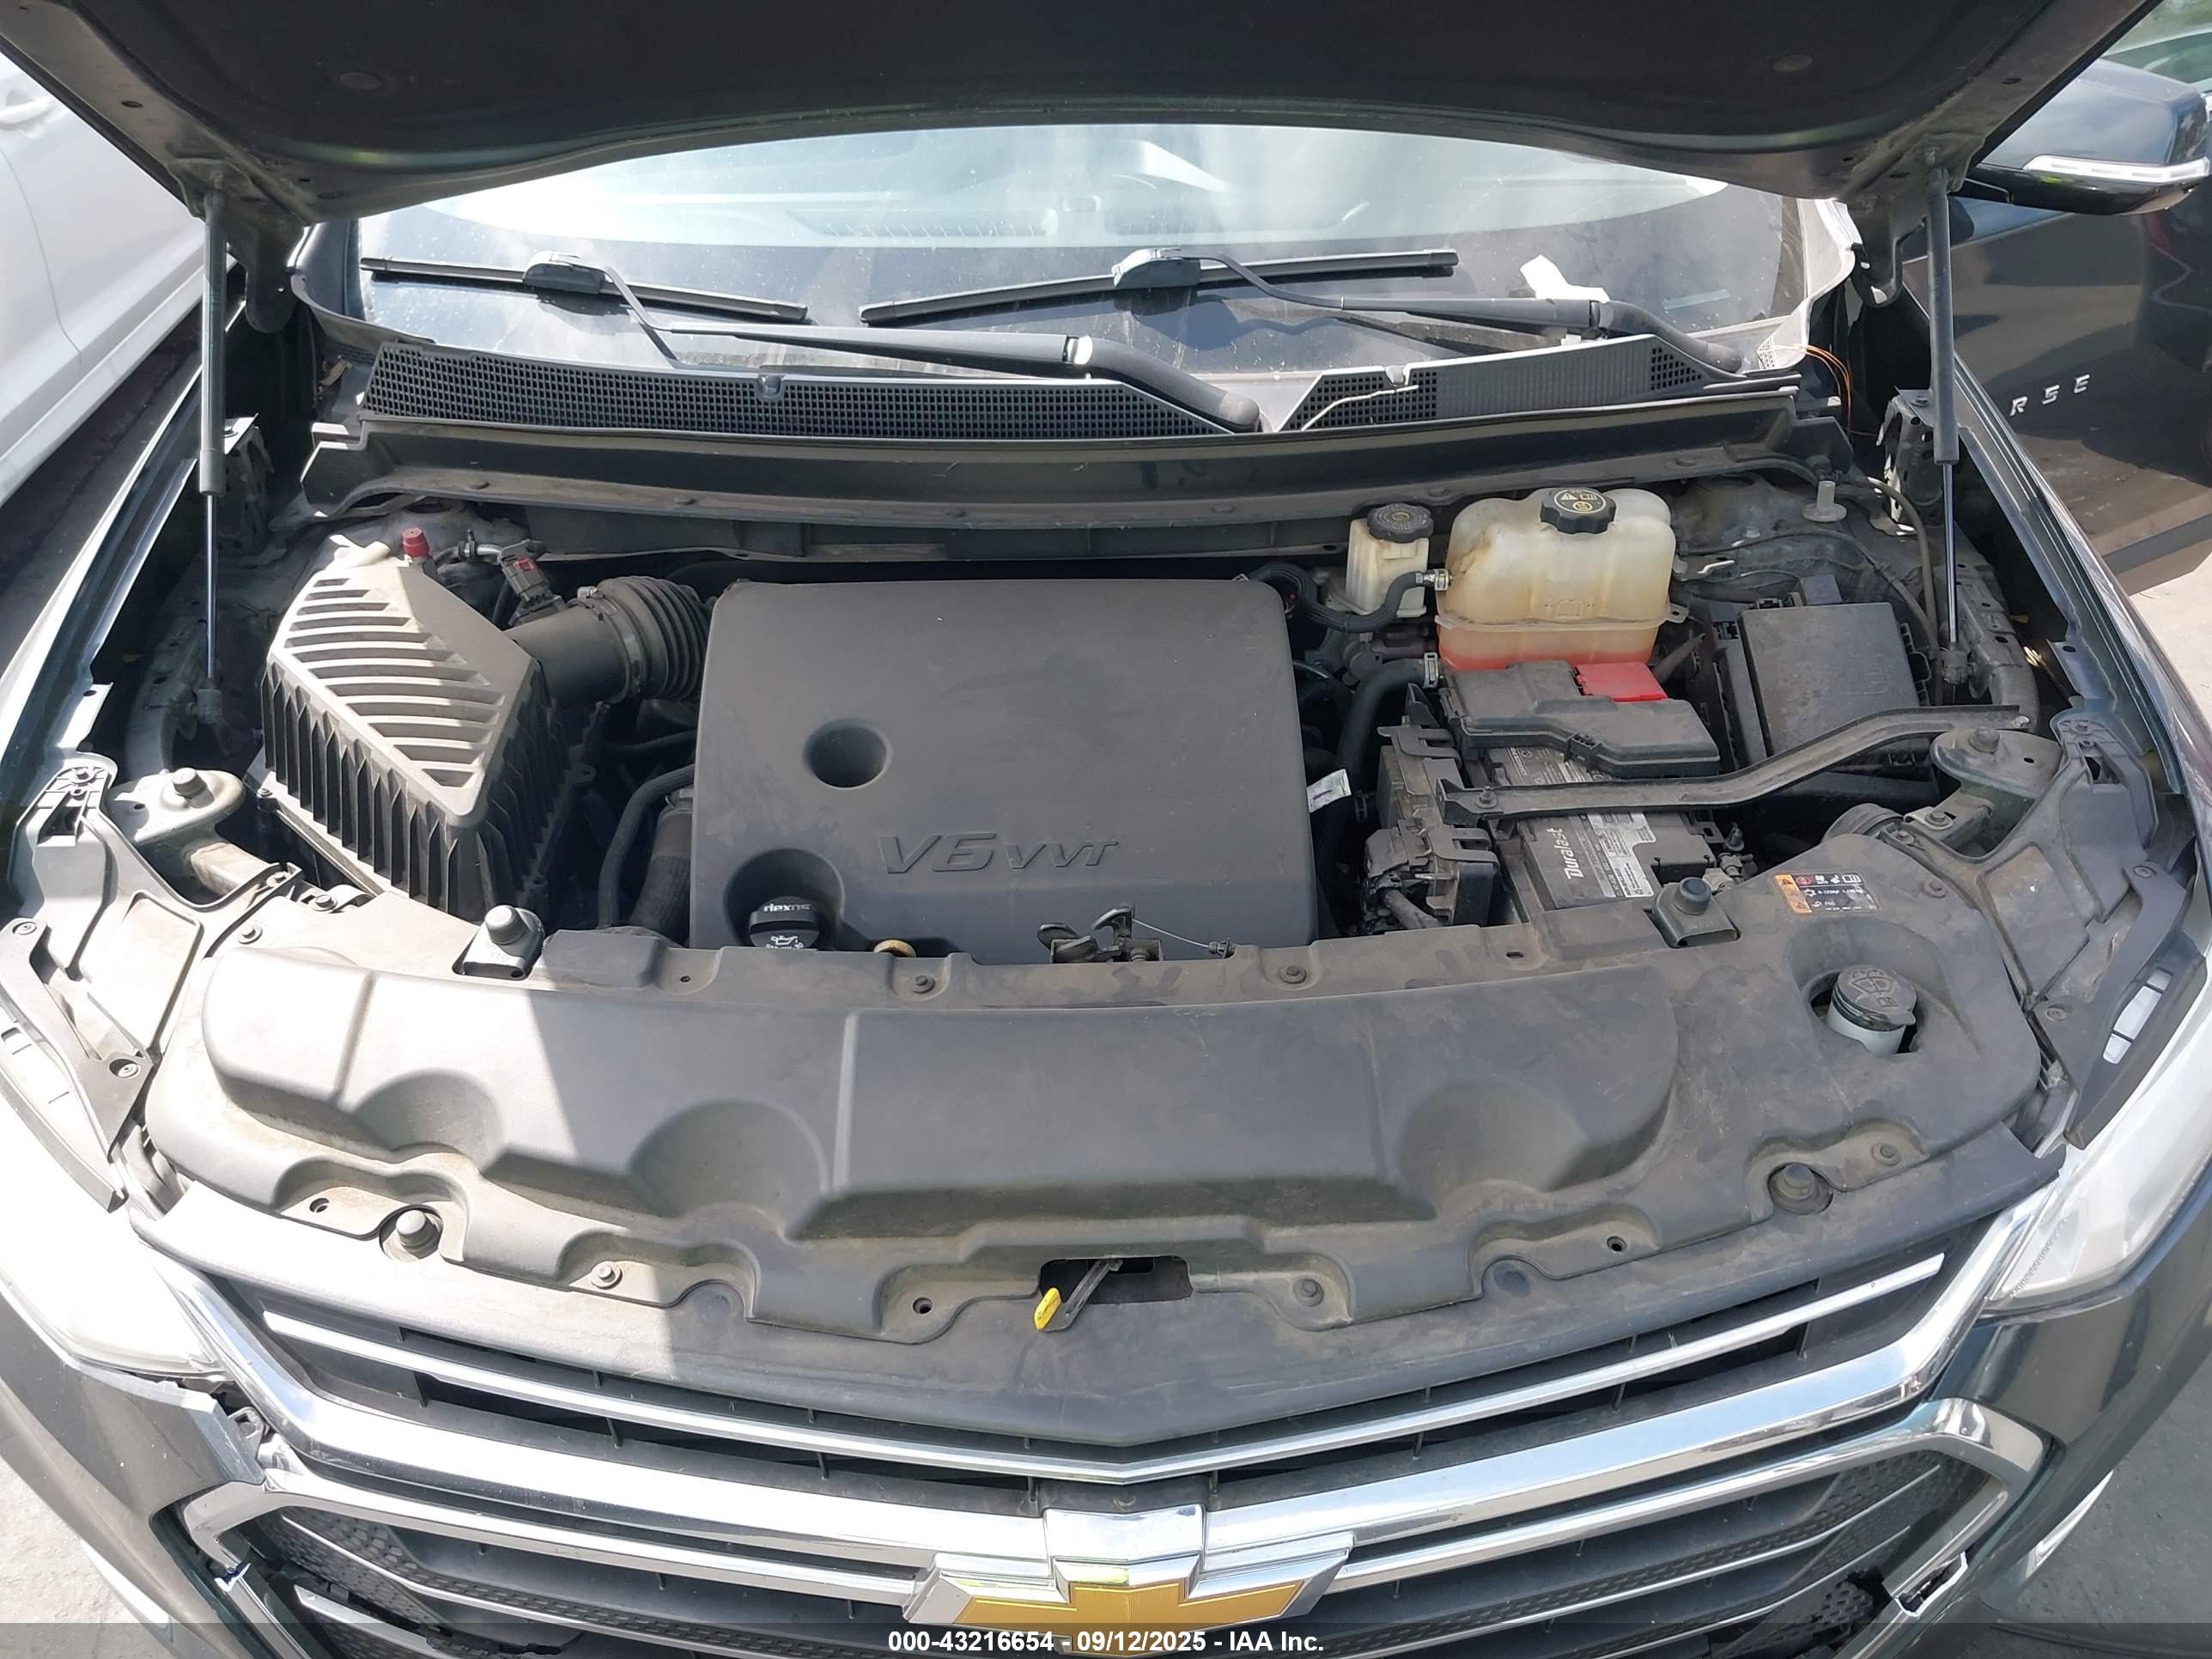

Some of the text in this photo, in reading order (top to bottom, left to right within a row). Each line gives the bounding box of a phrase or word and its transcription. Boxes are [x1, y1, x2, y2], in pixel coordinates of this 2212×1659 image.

[877, 831, 1119, 874] V6 VVT
[1547, 826, 1584, 880] Duralast
